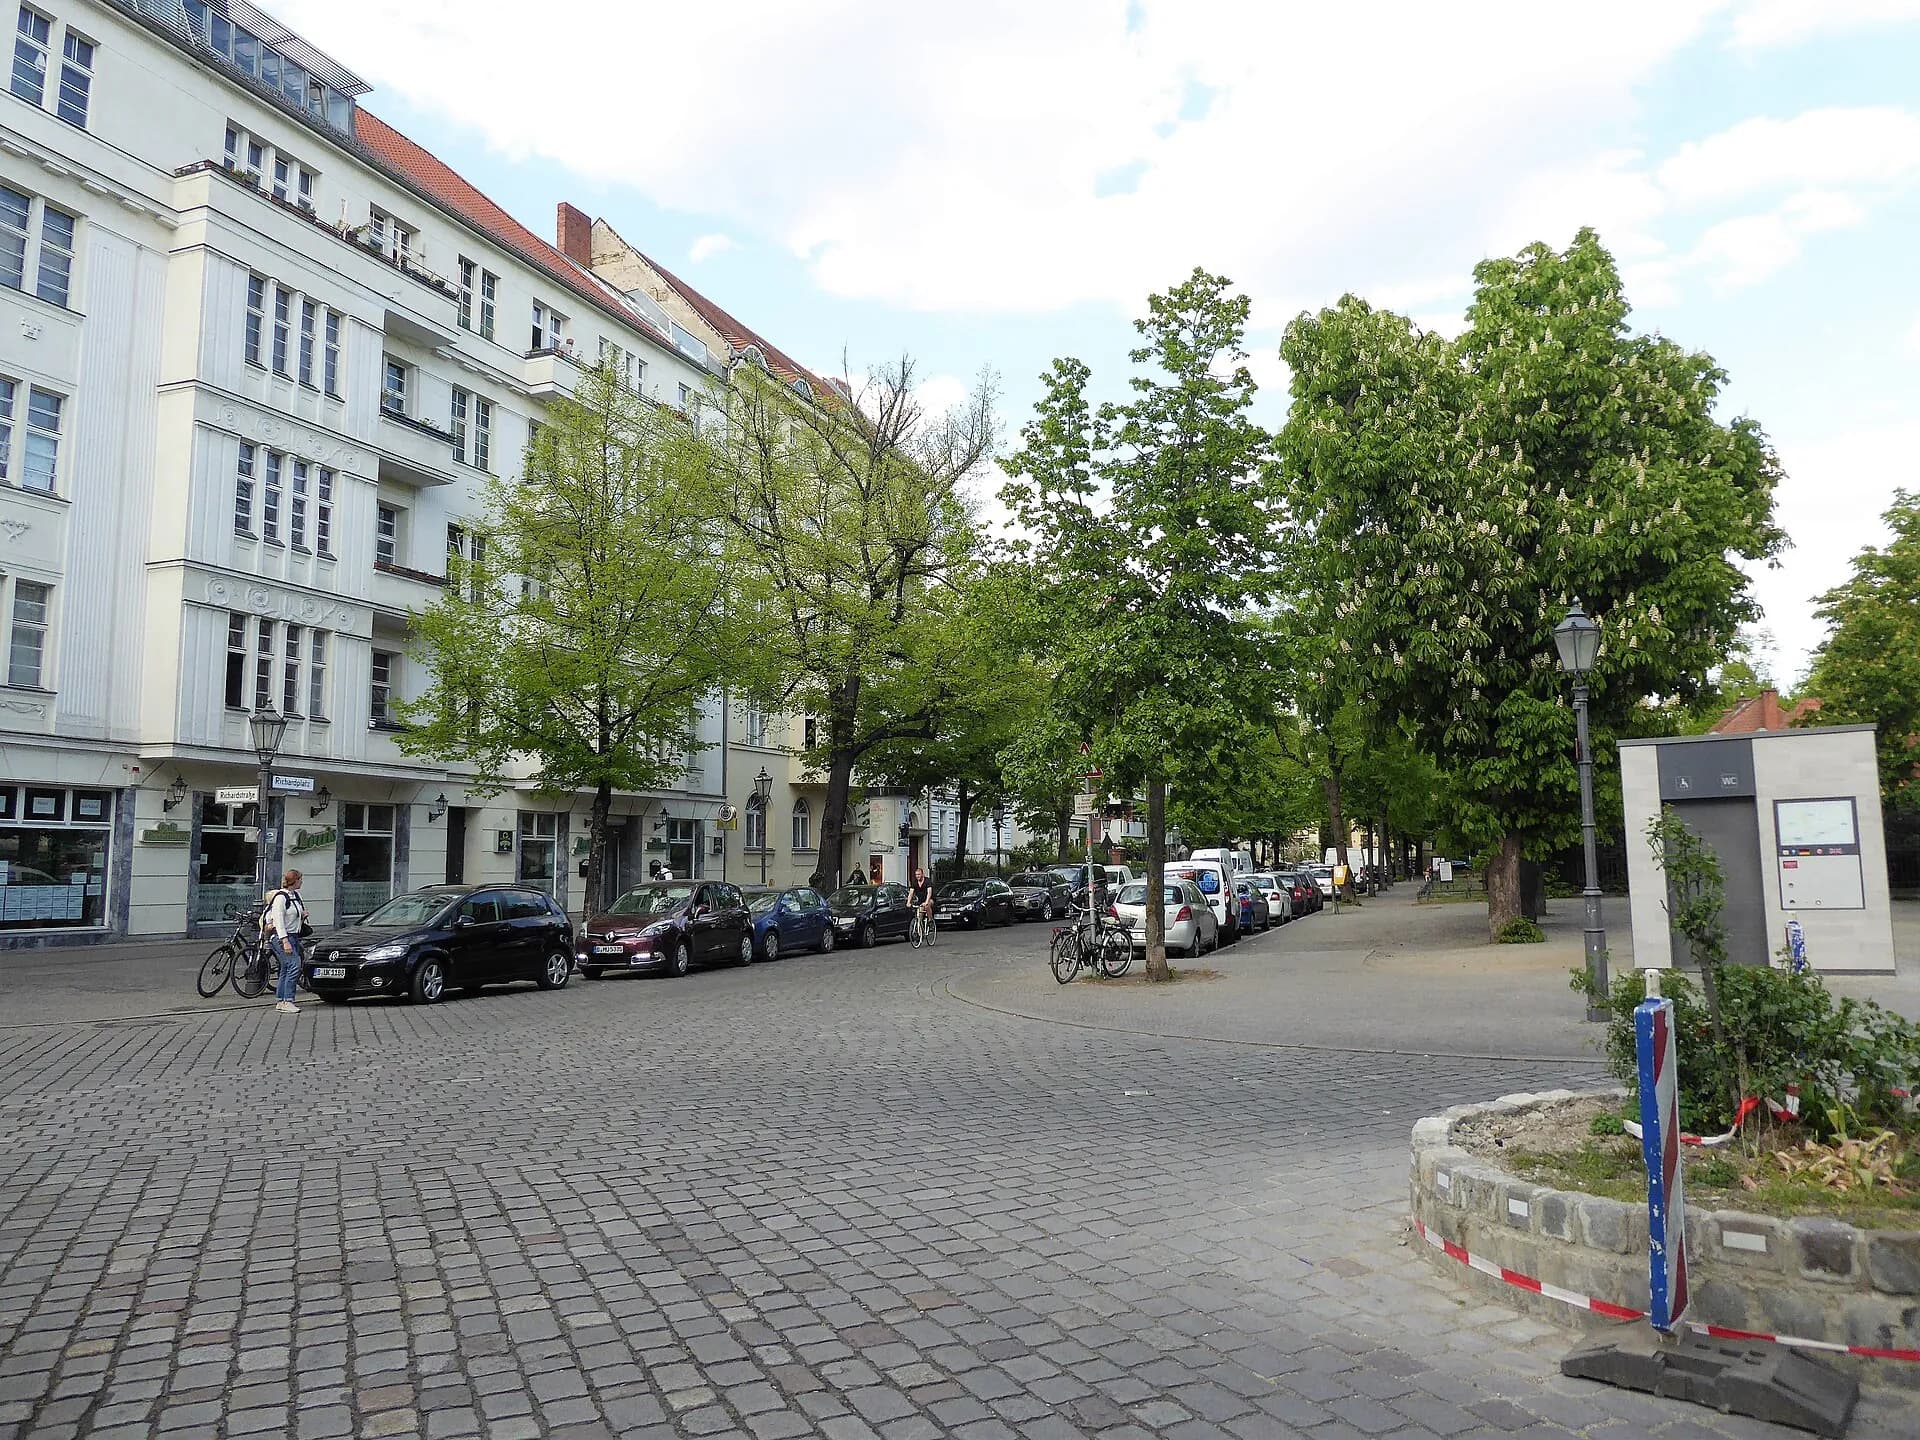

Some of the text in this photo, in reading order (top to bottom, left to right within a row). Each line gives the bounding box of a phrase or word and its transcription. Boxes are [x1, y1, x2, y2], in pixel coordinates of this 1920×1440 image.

[275, 776, 311, 788] Richardplatz
[1721, 777, 1737, 785] WC
[220, 791, 256, 801] Richardstraße
